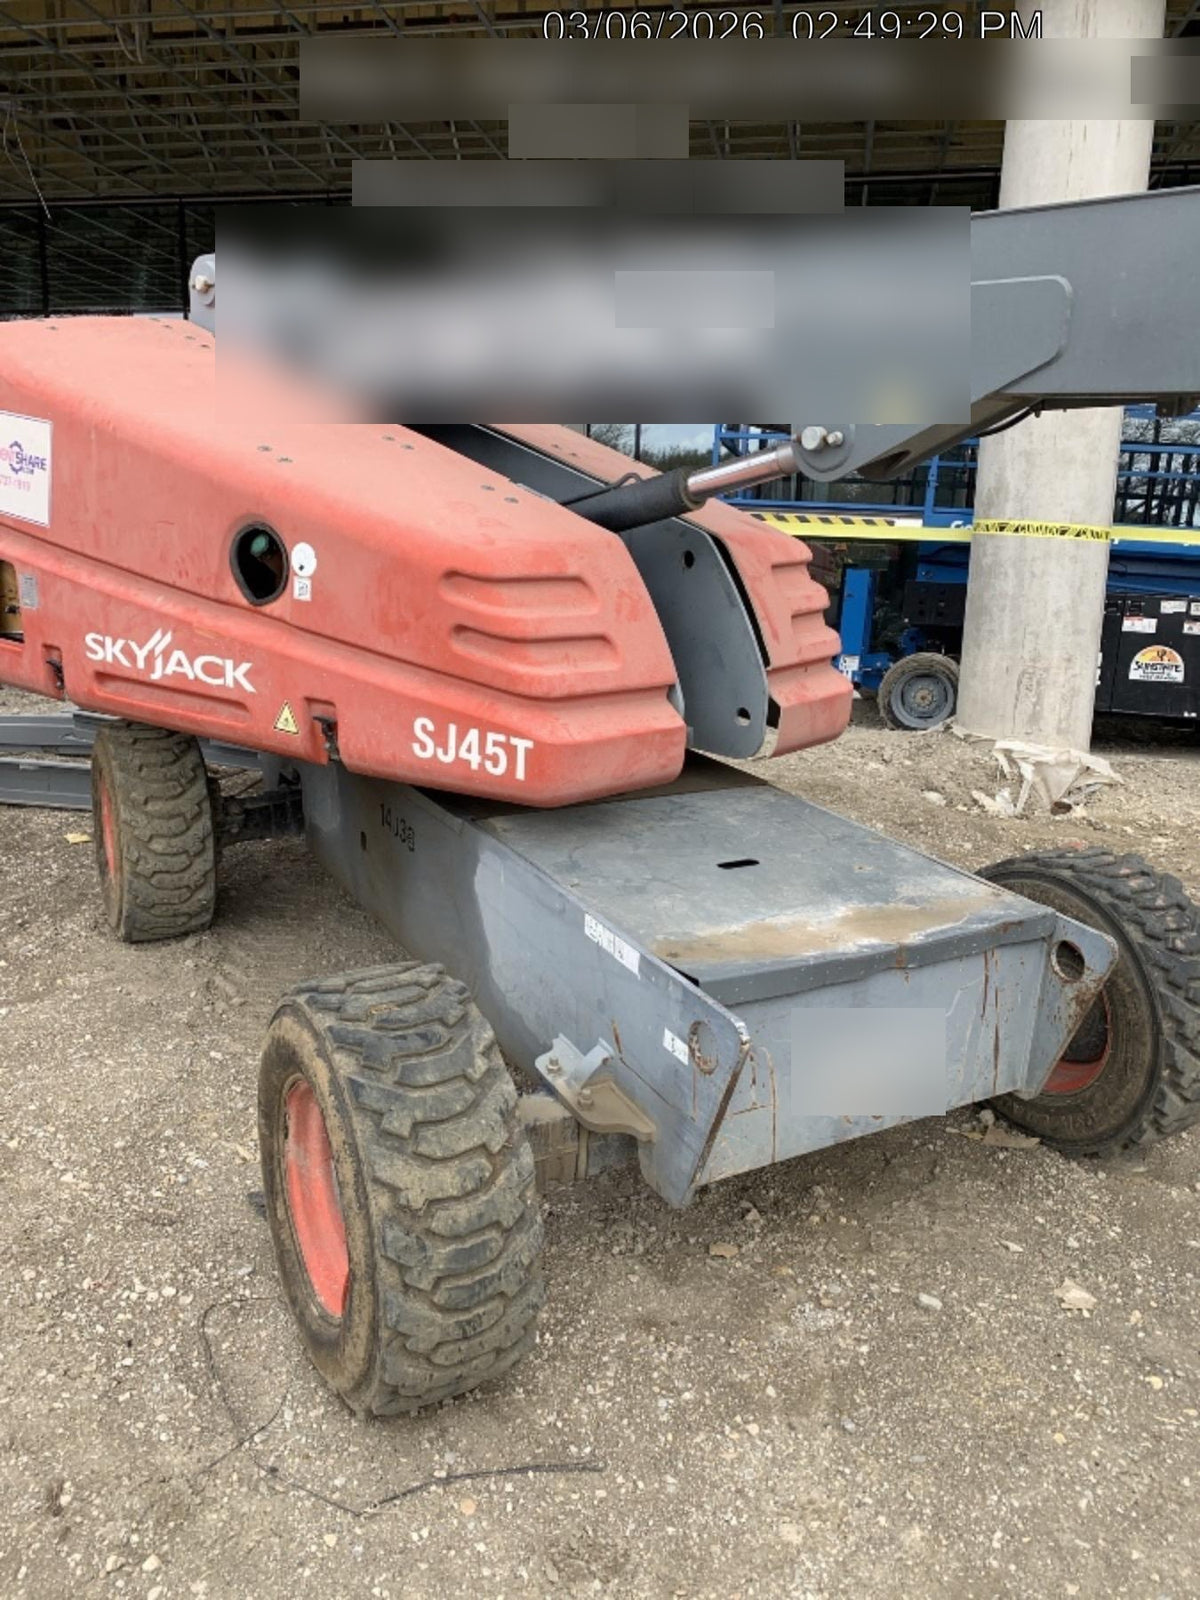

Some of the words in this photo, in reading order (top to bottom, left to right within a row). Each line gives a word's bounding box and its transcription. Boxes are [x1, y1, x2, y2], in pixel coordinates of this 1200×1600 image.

[15, 451, 47, 472] SHARE
[85, 628, 256, 693] SKYJACK
[412, 716, 534, 781] SJ45T
